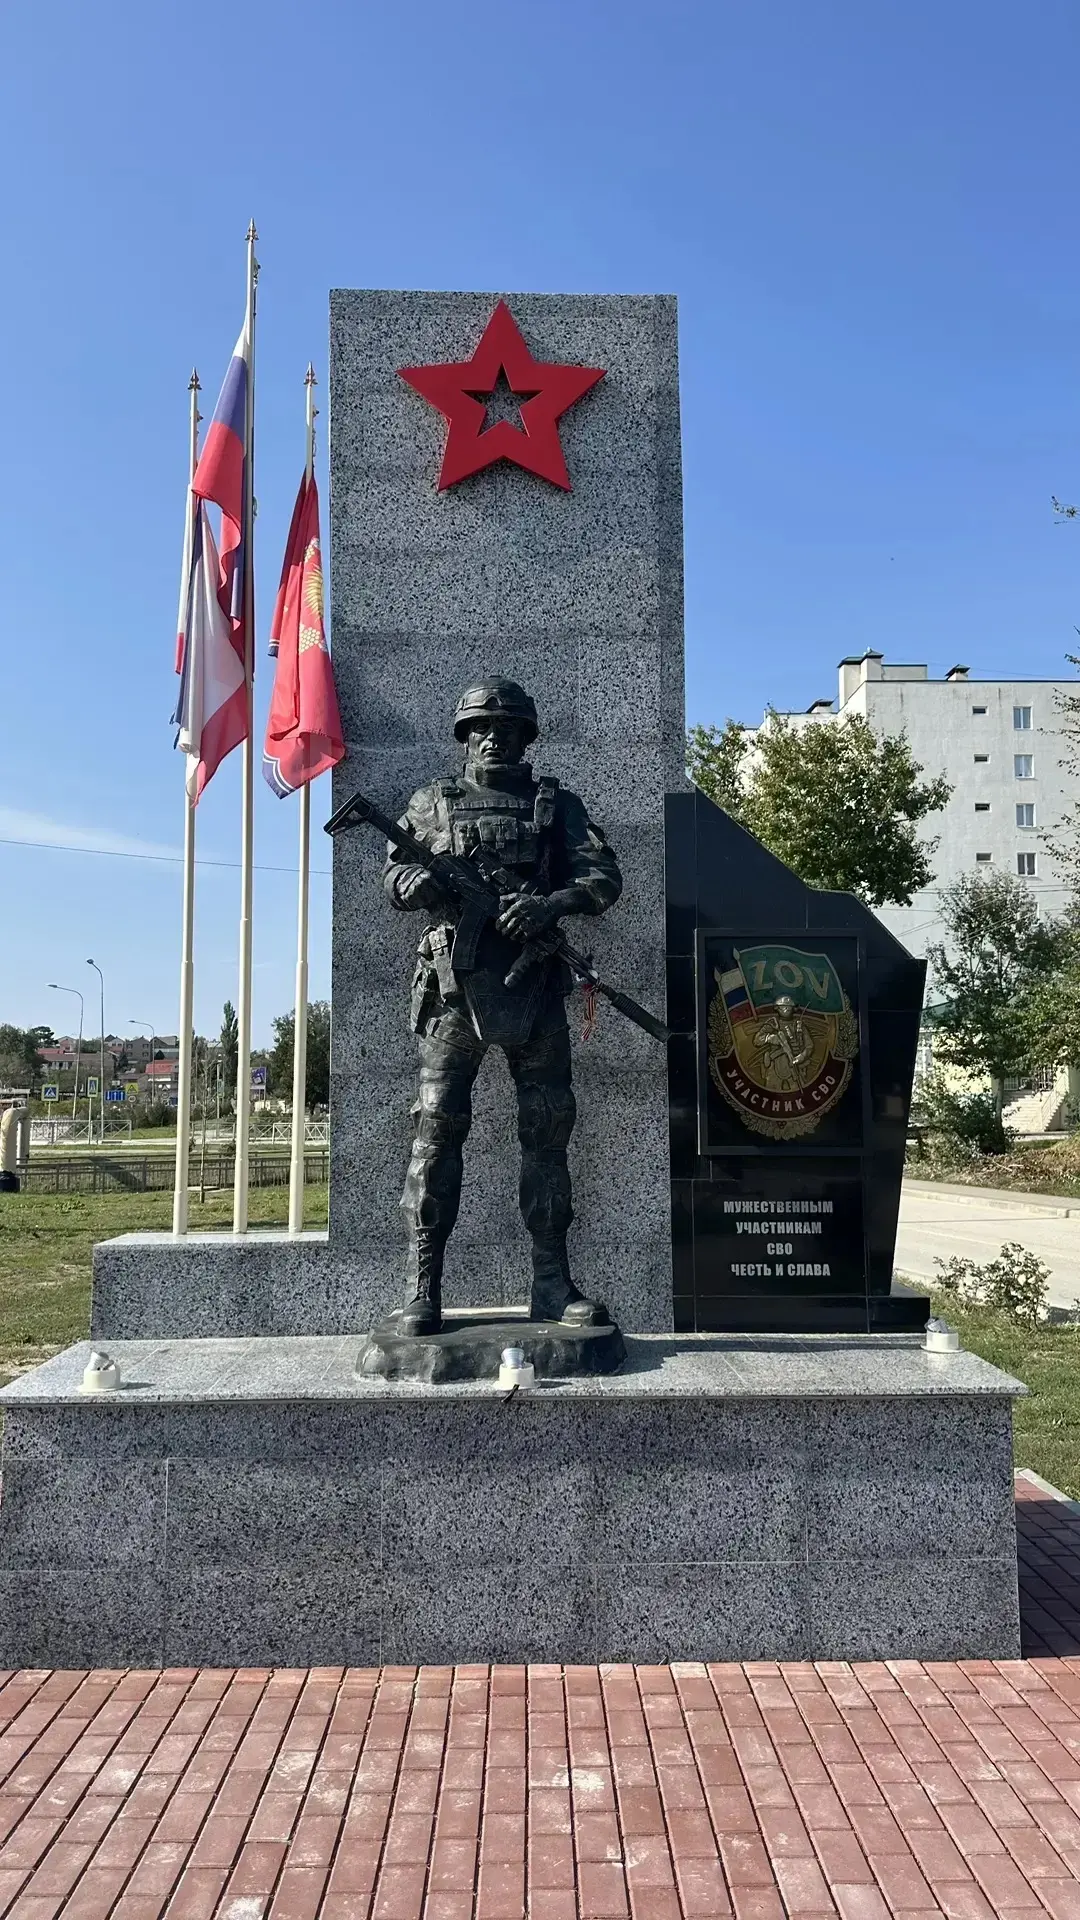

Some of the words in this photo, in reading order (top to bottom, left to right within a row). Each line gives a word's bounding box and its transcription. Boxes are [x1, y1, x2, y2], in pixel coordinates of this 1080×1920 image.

[749, 960, 831, 1000] ZOV
[726, 1069, 805, 1112] УЧАСТНИК
[811, 1074, 836, 1102] СВО
[723, 1201, 833, 1213] МУЖЕСТВЕННЫМ
[736, 1222, 822, 1234] УЧАСТНИКАМ
[766, 1243, 793, 1255] СВО
[731, 1264, 772, 1276] ЧЕСТЬ
[775, 1264, 784, 1276] И
[787, 1264, 831, 1276] СЛАВА
